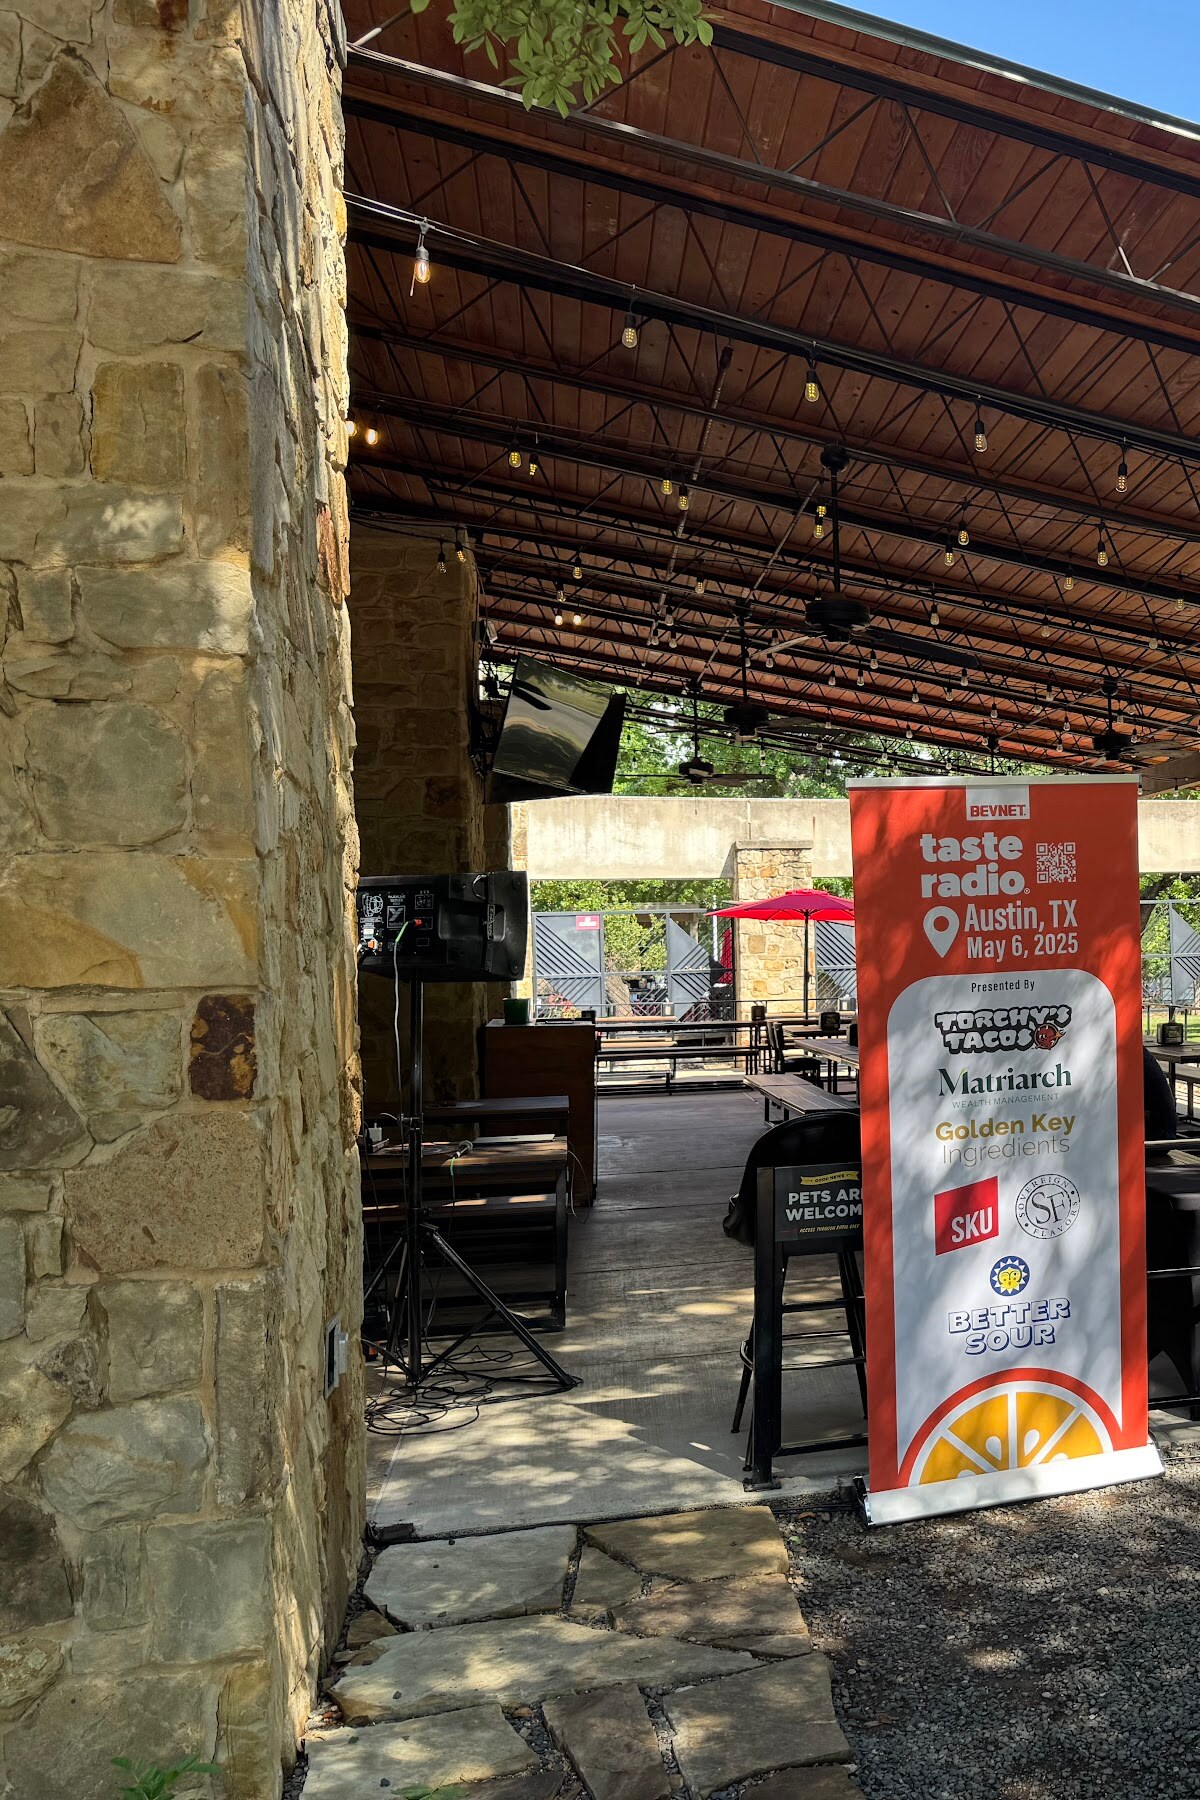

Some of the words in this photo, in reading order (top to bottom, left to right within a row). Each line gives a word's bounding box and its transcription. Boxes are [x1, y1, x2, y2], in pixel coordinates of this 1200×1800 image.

[920, 832, 1023, 862] taste
[964, 901, 1044, 932] Austin,
[1049, 900, 1078, 928] TX
[967, 936, 1006, 962] May
[1012, 935, 1028, 959] 6,
[1034, 933, 1078, 955] 2025
[971, 980, 1020, 993] Presented
[1024, 980, 1035, 992] By
[934, 1004, 1072, 1031] TORCHY'S
[943, 1028, 1033, 1054] TACOS
[938, 1063, 1072, 1096] Matriarch
[952, 1098, 990, 1109] WEALTH
[993, 1093, 1059, 1106] MANAGEMENT
[935, 1119, 1024, 1141] Golden
[1032, 1114, 1076, 1136] Key
[943, 1136, 1070, 1168] Ingredients
[788, 1190, 831, 1205] PETS
[836, 1188, 863, 1202] AR
[1018, 1177, 1069, 1218] SOVEREIGN
[1032, 1192, 1065, 1224] SF
[786, 1204, 862, 1222] WELCOM
[951, 1206, 994, 1243] SKU
[1033, 1201, 1078, 1236] FLAVORS
[948, 1298, 1071, 1334] BETTER
[965, 1323, 1056, 1355] SOUR
